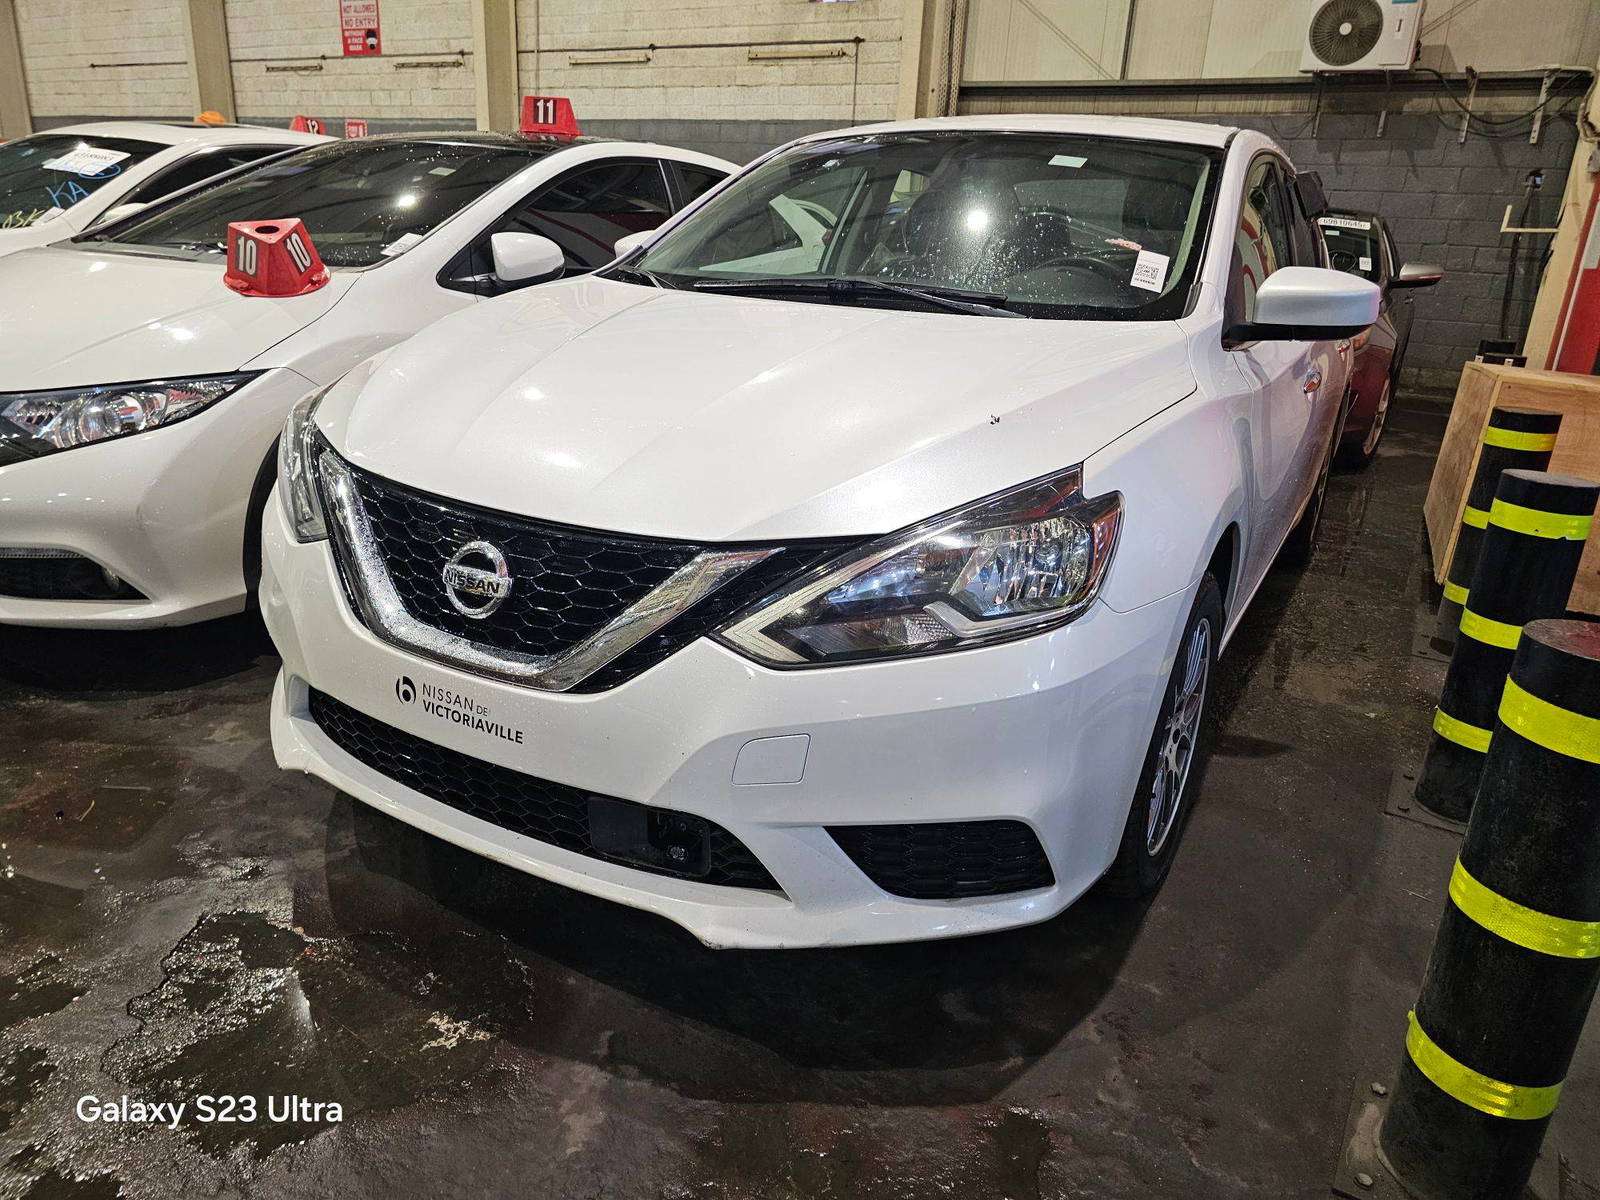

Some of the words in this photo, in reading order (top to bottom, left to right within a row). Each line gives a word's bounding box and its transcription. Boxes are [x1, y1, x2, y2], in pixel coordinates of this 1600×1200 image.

[344, 18, 354, 27] NO
[355, 17, 376, 27] ENTRY
[536, 99, 554, 124] 11
[237, 235, 257, 276] 10
[286, 232, 312, 273] 10
[443, 567, 501, 594] NISSAN
[422, 683, 474, 712] NISSAN
[476, 705, 488, 717] DE
[422, 699, 523, 745] VICTORIAVILLE
